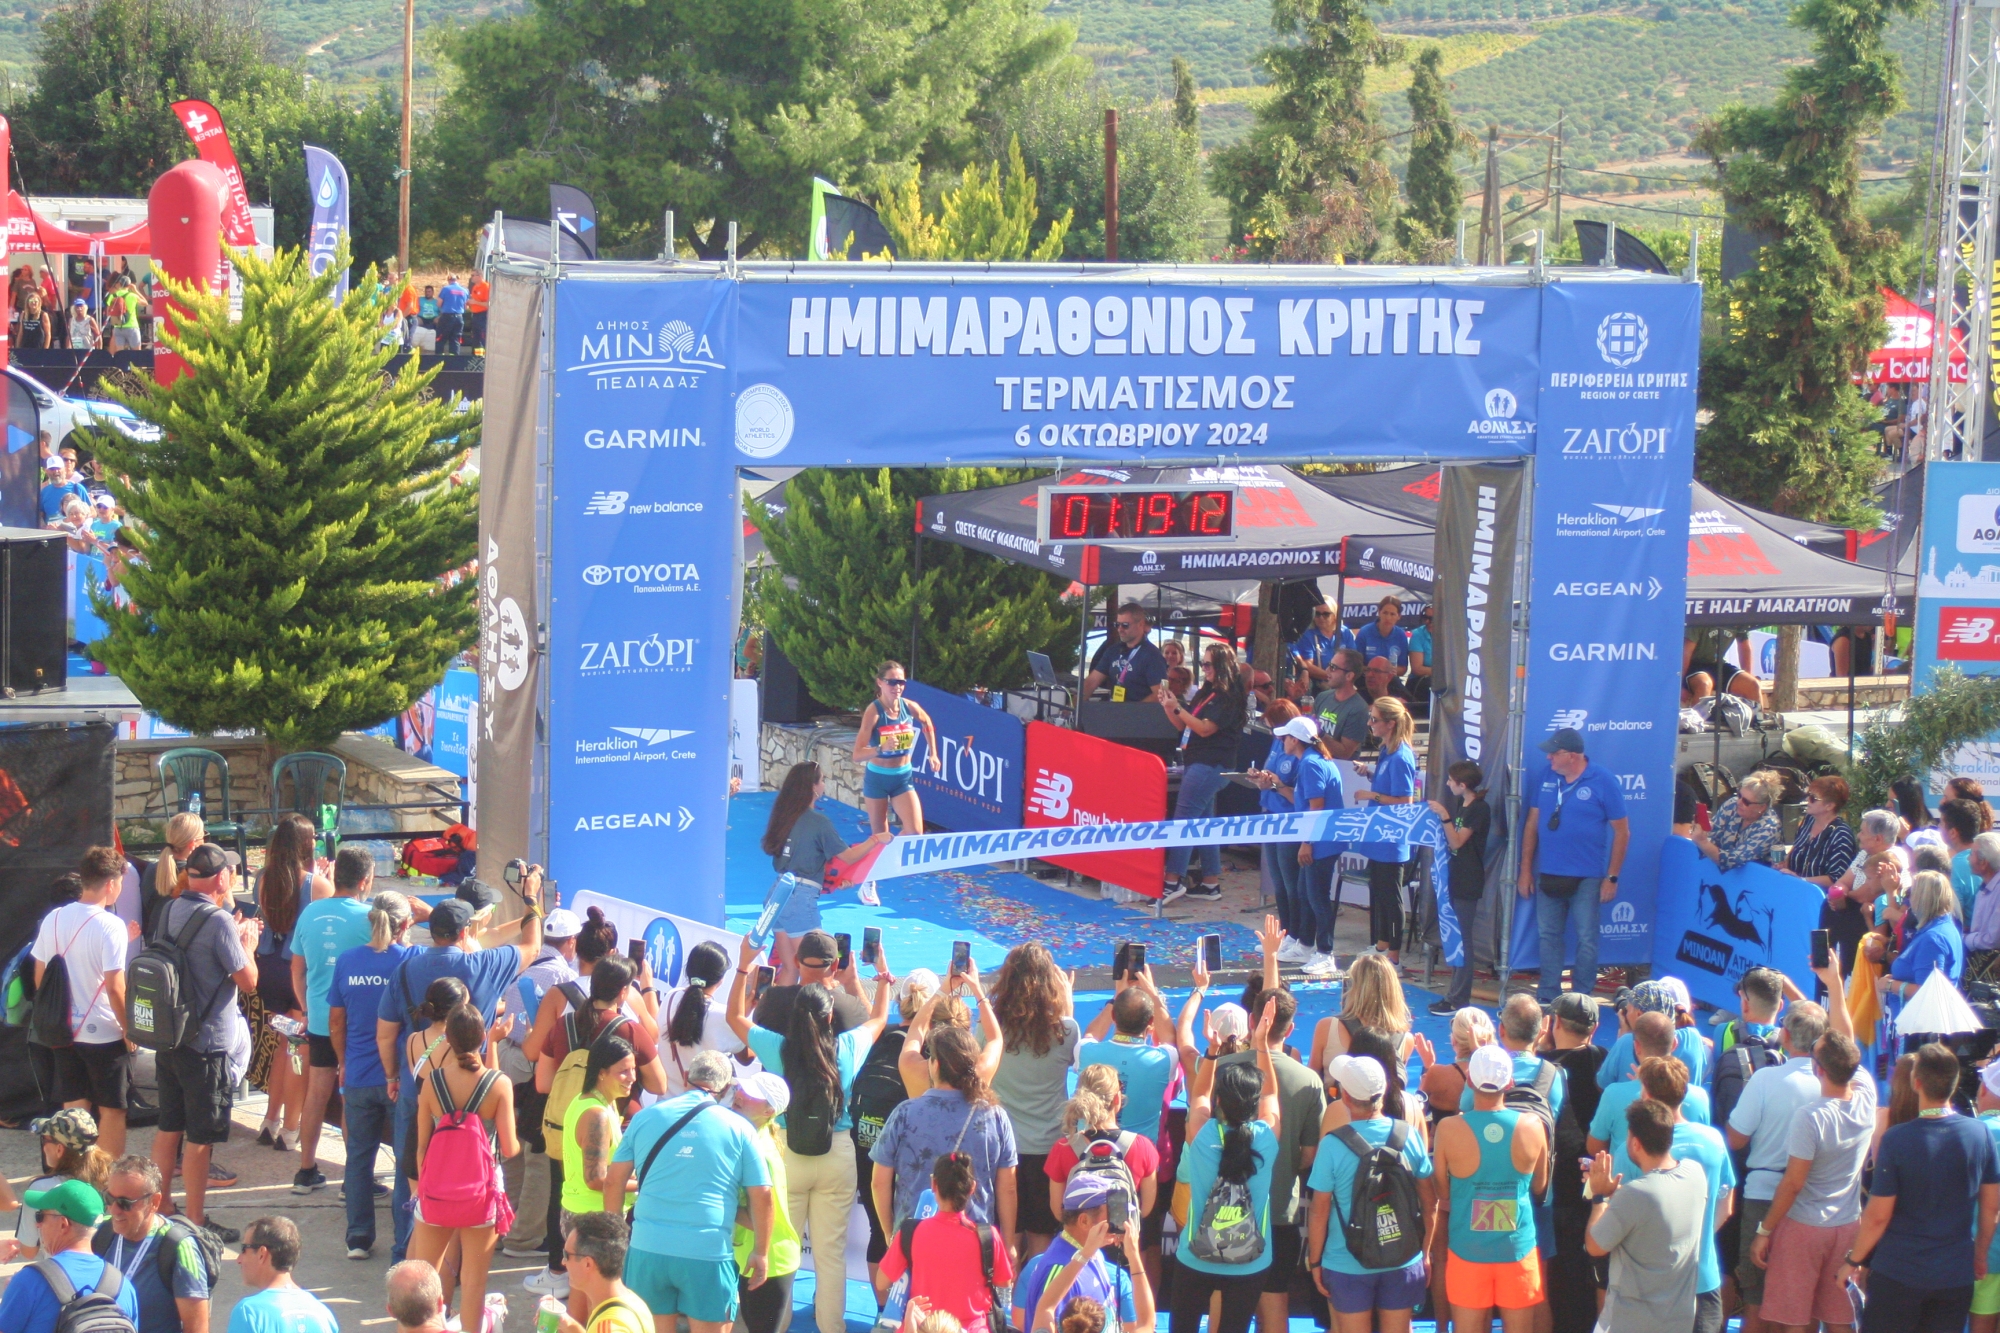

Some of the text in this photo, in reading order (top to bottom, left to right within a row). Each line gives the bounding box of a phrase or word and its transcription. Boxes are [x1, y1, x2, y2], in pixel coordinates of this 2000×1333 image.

[596, 321, 650, 331] ΔΗΜΟΣ
[788, 297, 1485, 357] ΗΜΙΜΑΡΑΘΩΝΙΟΣ ΚΡΗΤΗΣ
[597, 376, 700, 391] ΠΕΔΙΑΔΑΣ
[1551, 373, 1688, 388] ΠΕΡΙΦΕΡΕΙΑ ΚΡΗΤΗΣ
[995, 375, 1296, 411] ΤΕΡΜΑΤΙΣΜΟΣ
[1580, 391, 1660, 400] REGION OF CRETE
[1014, 422, 1269, 447] 6 ΟΚΤΩΒΡΙΟΥ 2024
[629, 504, 652, 515] new
[654, 501, 703, 513] balance
[1556, 513, 1618, 526] Heraklion
[955, 520, 1041, 556] CRETE HALF MARATHON
[1556, 527, 1666, 539] International Airport, Crete
[1181, 550, 1320, 569] ΗΜΙΜΑΡΑΘΩΝΙΟΣ
[613, 563, 700, 584] TOYOTA
[1553, 582, 1643, 596] AEGEAN
[1709, 599, 1752, 614] HALF
[1757, 598, 1851, 613] MARATHON
[1587, 722, 1607, 732] new
[1609, 719, 1653, 731] balance
[576, 736, 638, 753] Heraklion
[575, 750, 696, 765] International Airport, Crete
[574, 812, 671, 832] AEGEAN
[901, 812, 1304, 867] ΗΜΙΜΑΡΑΘΩΝΙΟΣ ΚΡΗΤΗΣ
[1683, 938, 1726, 969] MINOAN
[348, 976, 382, 986] MAYO
[134, 1004, 153, 1019] RUN
[135, 1016, 153, 1027] CRETE
[1217, 1205, 1244, 1222] NIKE
